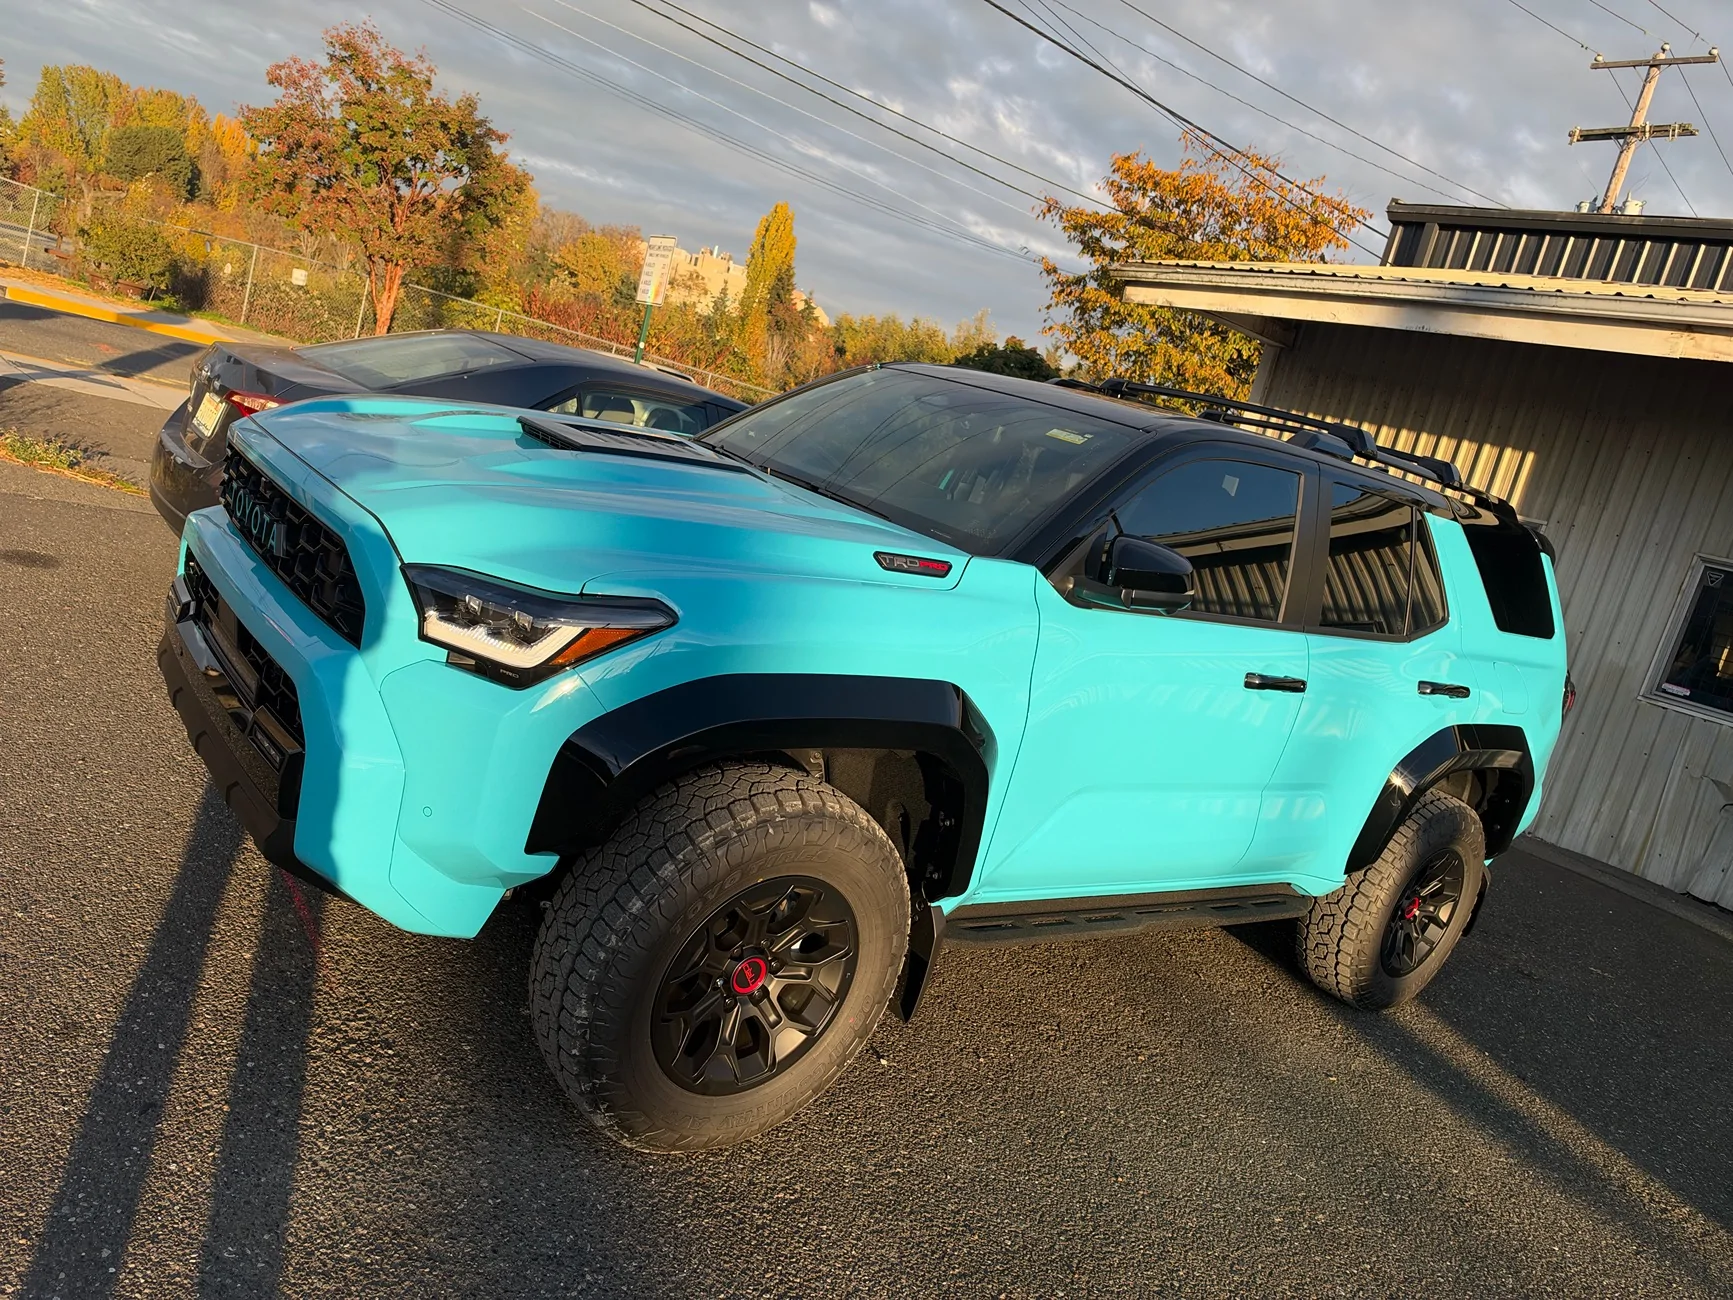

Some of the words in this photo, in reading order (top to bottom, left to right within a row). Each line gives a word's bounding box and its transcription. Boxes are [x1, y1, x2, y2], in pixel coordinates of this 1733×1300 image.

[226, 480, 278, 553] TOYOTA
[879, 554, 919, 569] TRD
[919, 560, 949, 571] PRO
[499, 668, 520, 679] PRO
[669, 868, 743, 935] TOYO
[749, 850, 834, 874] TIRES
[829, 994, 875, 1065] OPEN
[716, 1062, 827, 1130] COUNTRY
